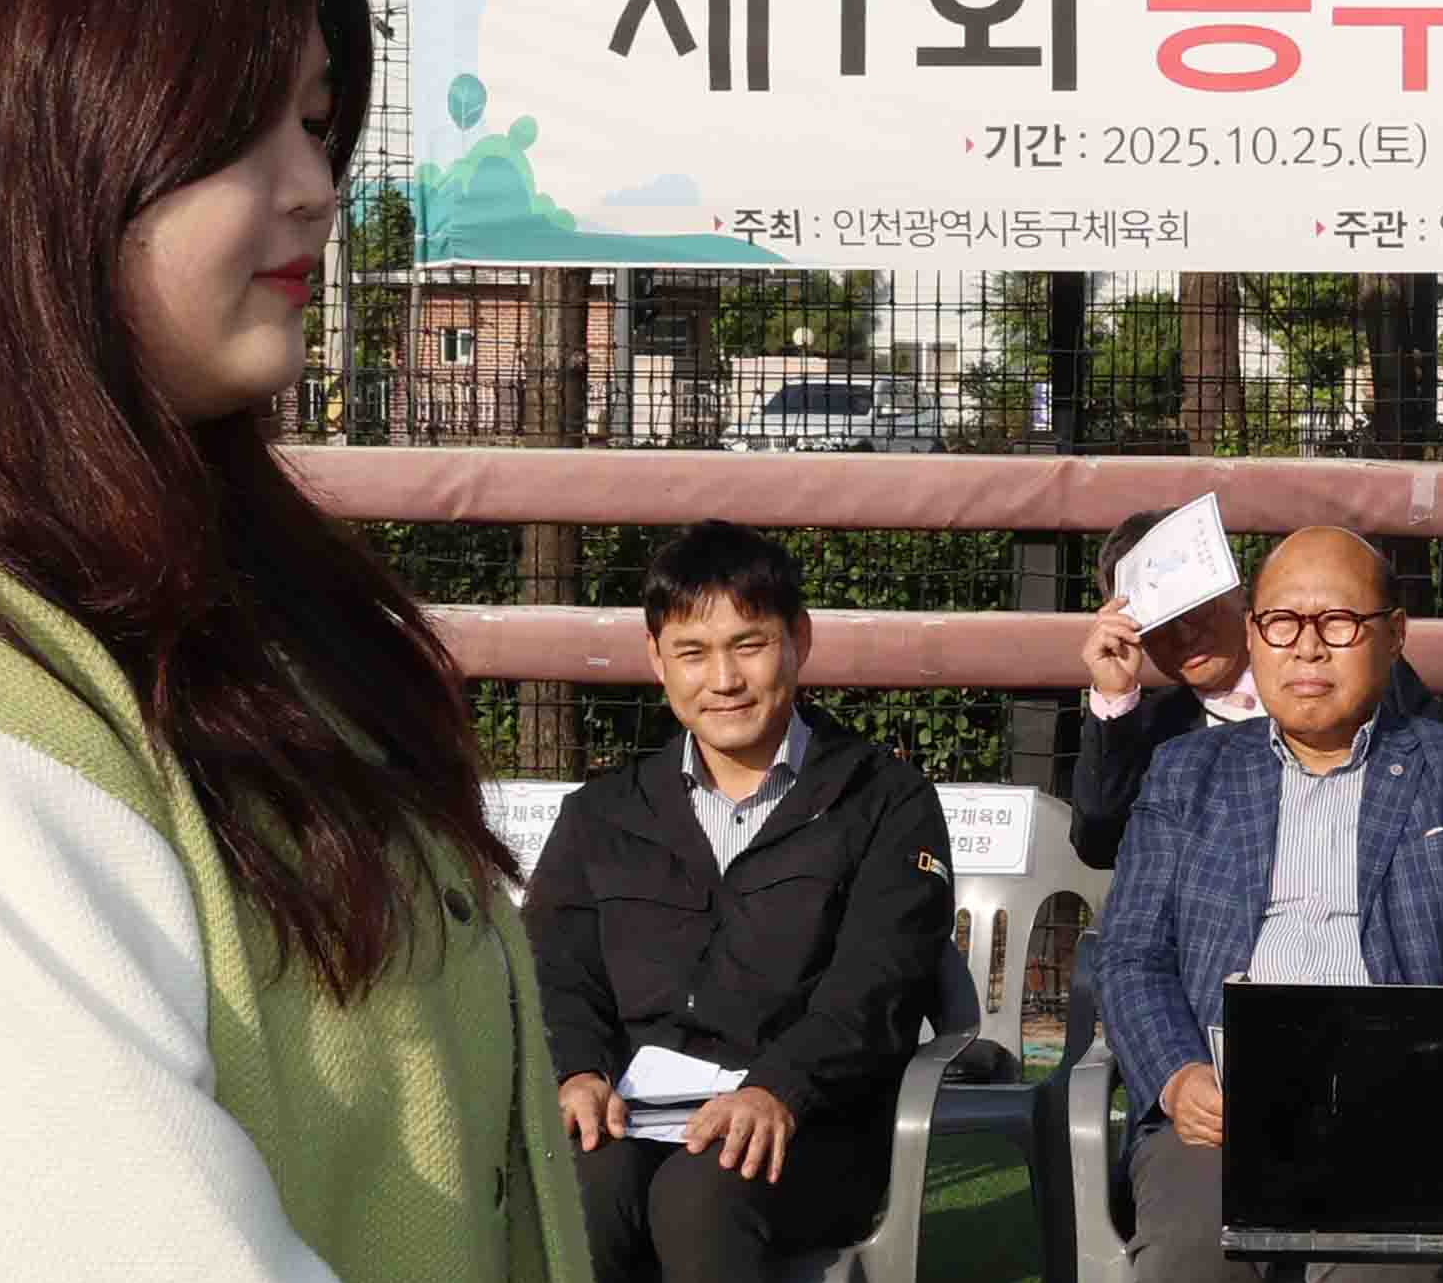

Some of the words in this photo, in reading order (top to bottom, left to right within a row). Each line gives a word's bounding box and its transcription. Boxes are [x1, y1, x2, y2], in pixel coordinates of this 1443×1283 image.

[985, 124, 1067, 168] 기간
[1103, 124, 1427, 167] 2025.10.25.(토)
[733, 209, 801, 247] 주최
[834, 210, 1188, 248] 인천광역시동구체육회
[1333, 211, 1408, 249] 주관
